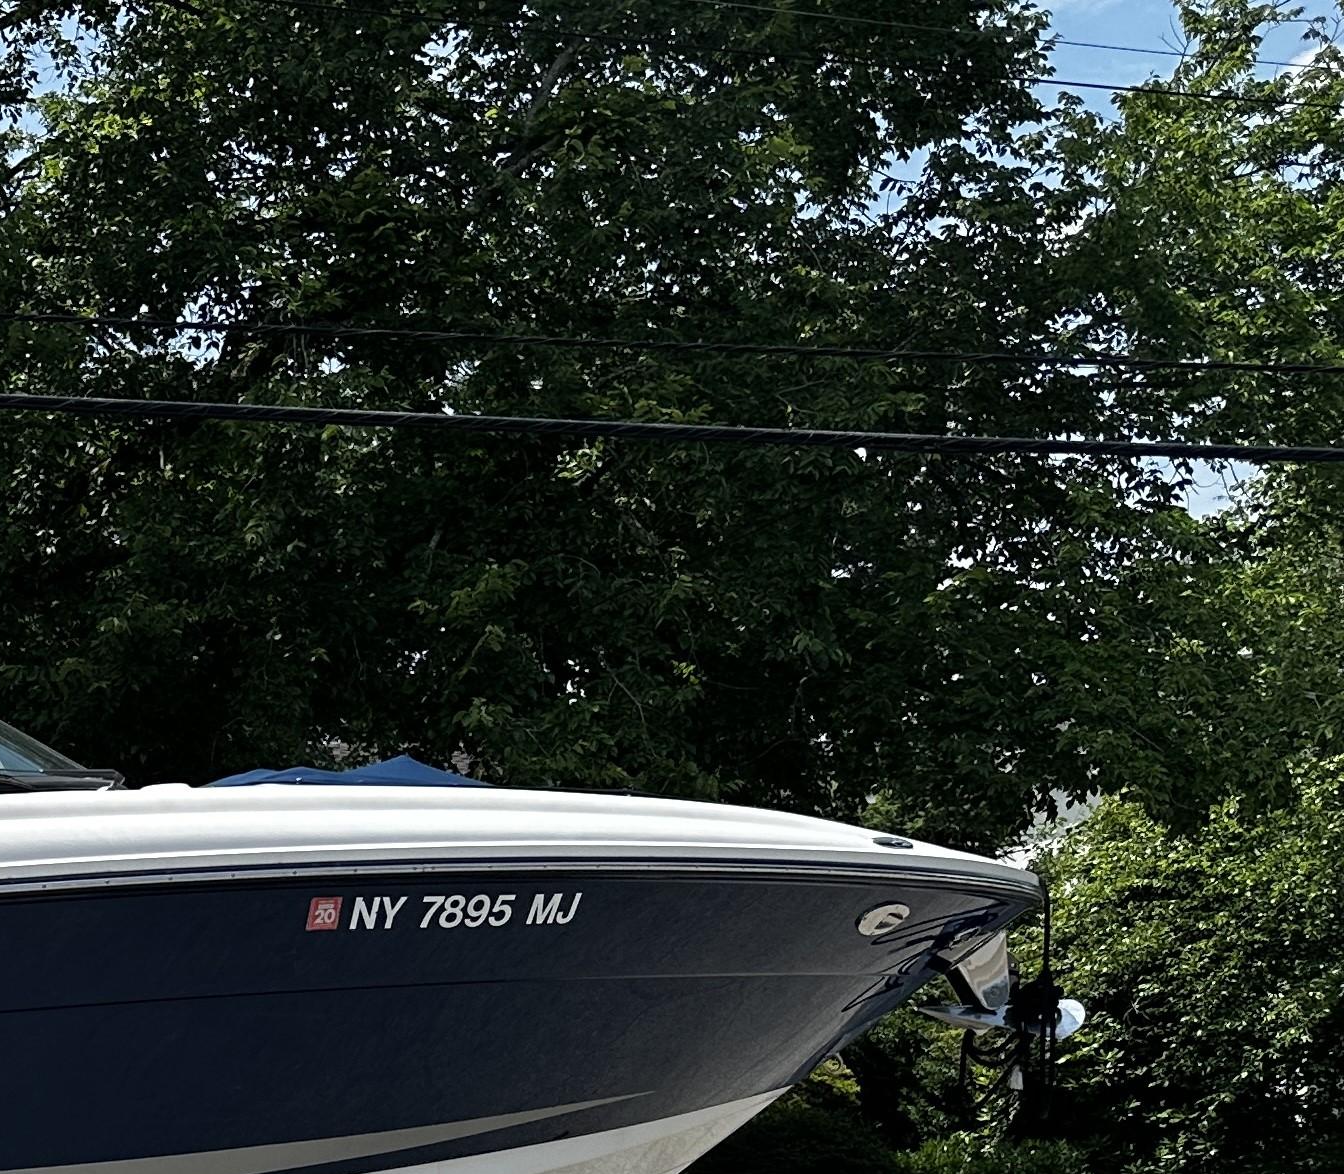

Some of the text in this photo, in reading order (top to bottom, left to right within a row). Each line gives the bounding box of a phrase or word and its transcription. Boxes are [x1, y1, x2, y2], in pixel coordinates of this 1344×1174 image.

[314, 909, 335, 924] 20
[349, 892, 583, 930] NY 7895 MJ
